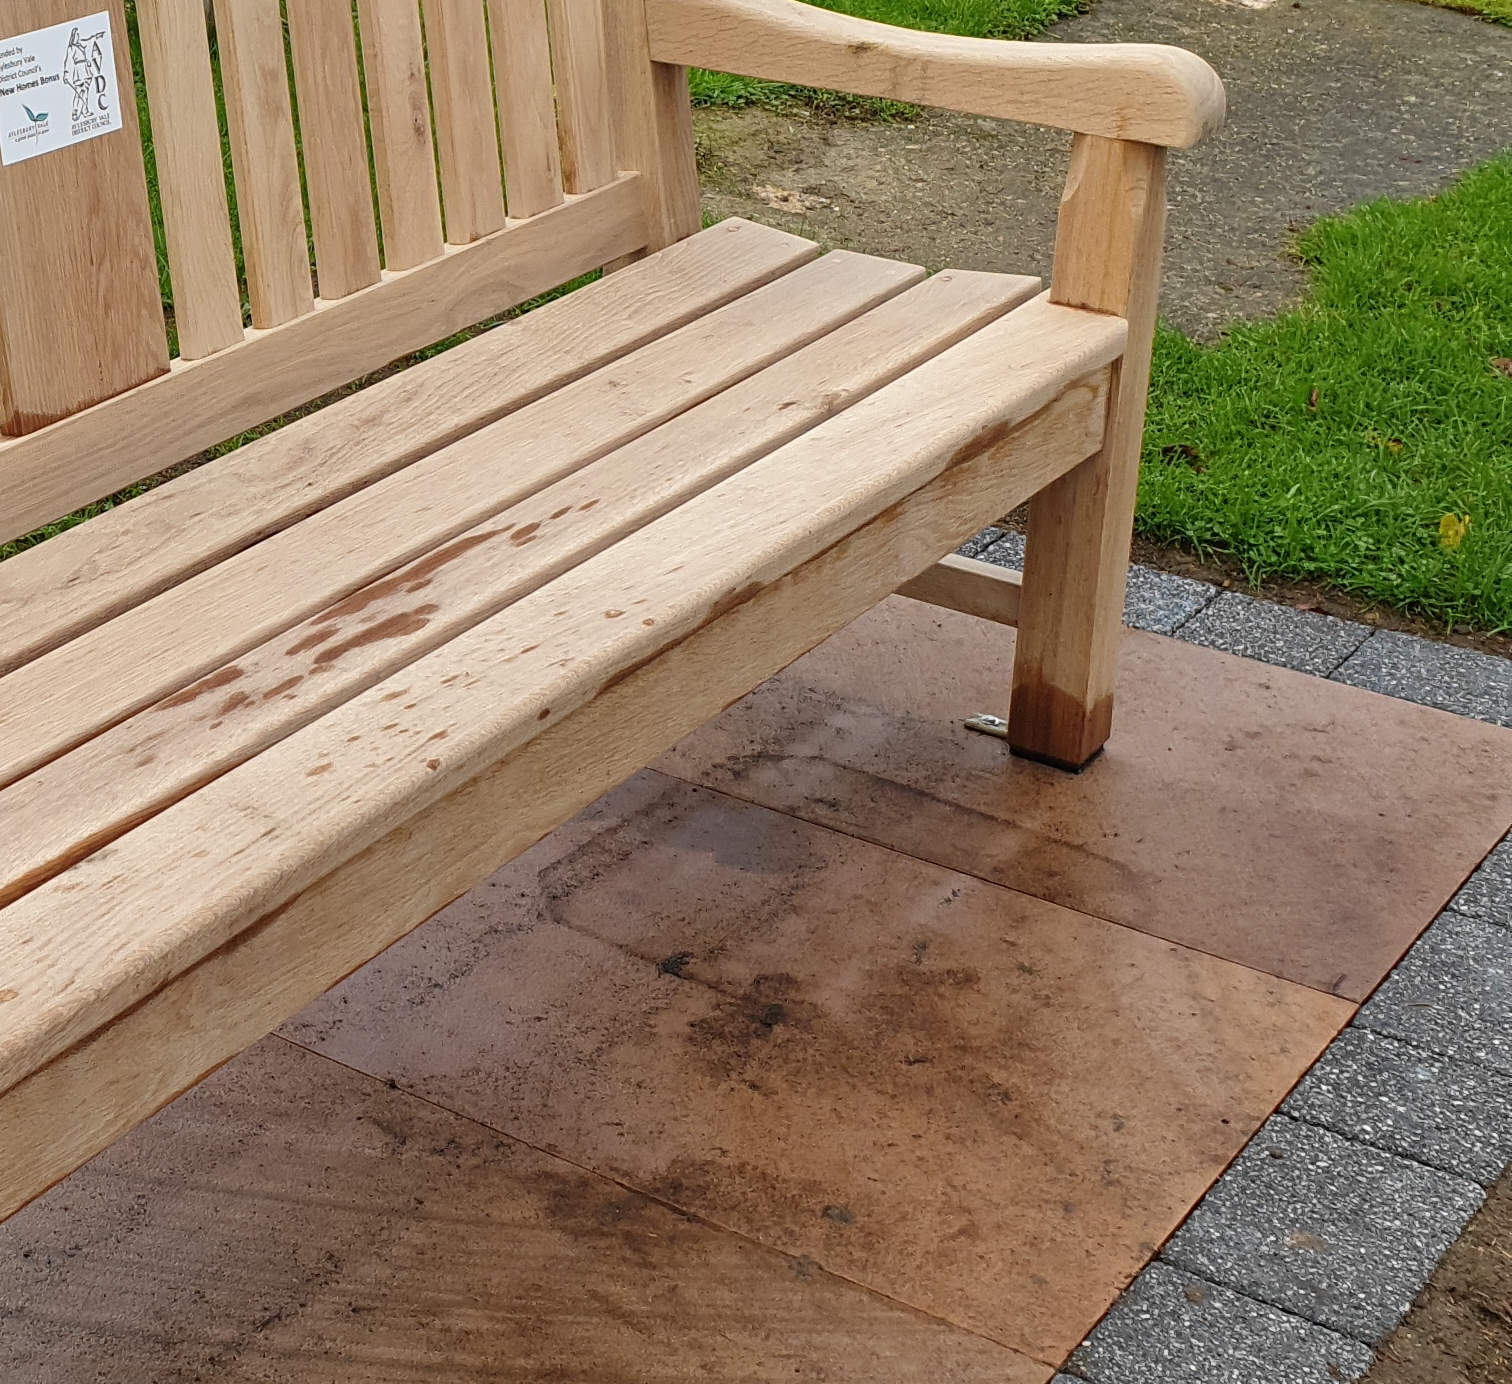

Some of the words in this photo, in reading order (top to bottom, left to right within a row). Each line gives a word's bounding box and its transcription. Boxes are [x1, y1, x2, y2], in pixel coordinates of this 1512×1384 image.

[0, 87, 15, 97] New
[16, 79, 39, 92] Homes
[39, 73, 60, 86] Bonus
